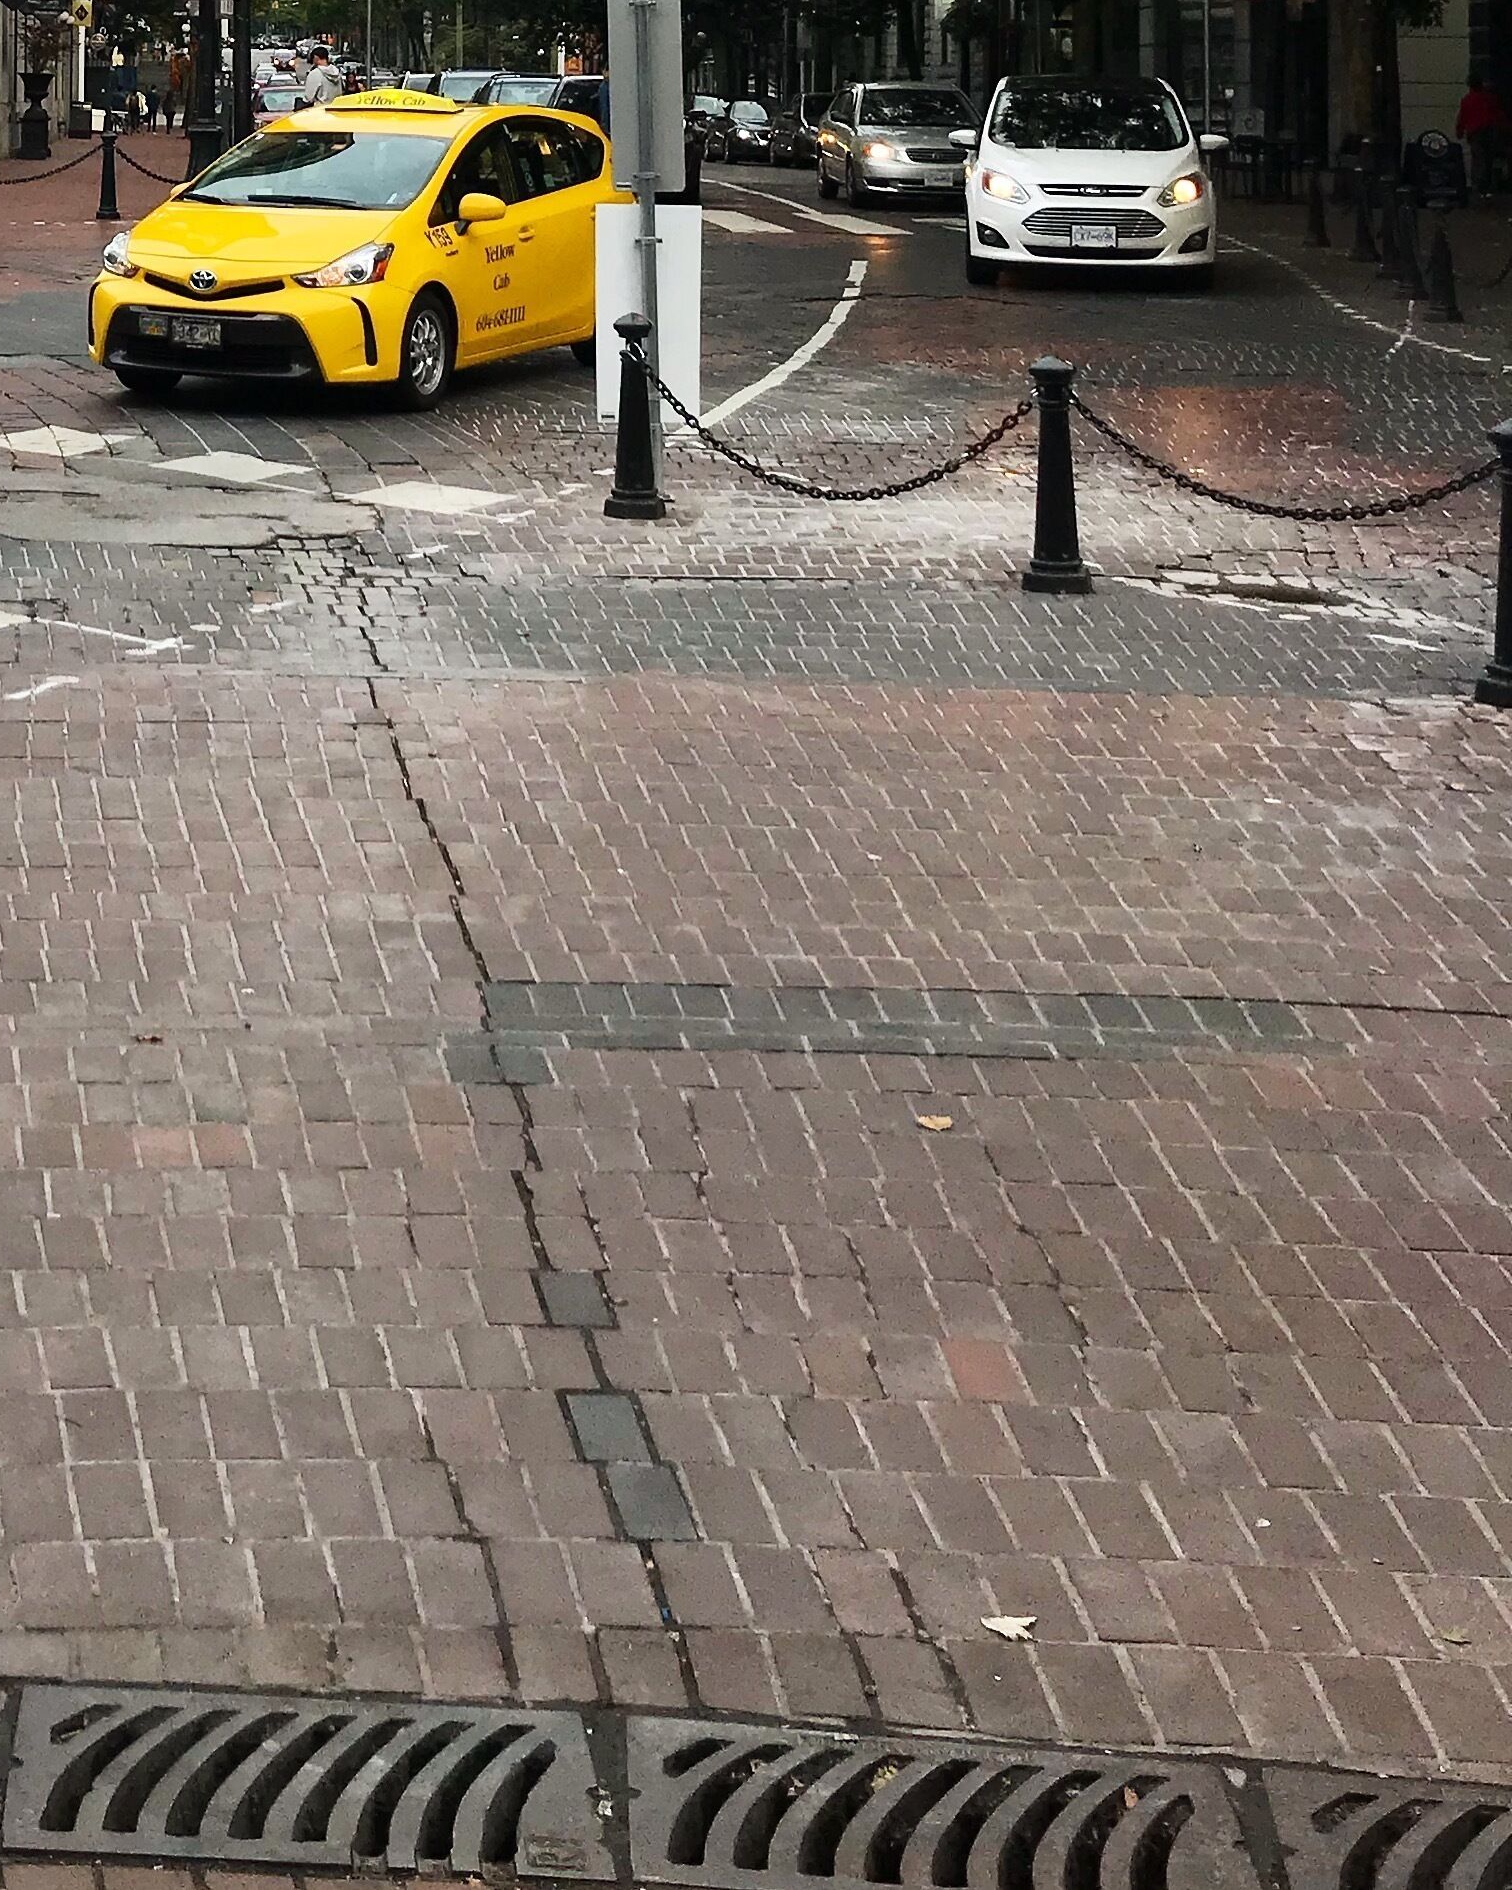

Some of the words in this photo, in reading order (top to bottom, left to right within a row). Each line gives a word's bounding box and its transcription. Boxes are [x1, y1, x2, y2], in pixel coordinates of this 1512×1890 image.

[357, 95, 397, 106] Yellow
[402, 96, 426, 106] Cab
[424, 227, 453, 249] Y159
[485, 244, 515, 264] Yellow
[493, 272, 511, 291] Cab
